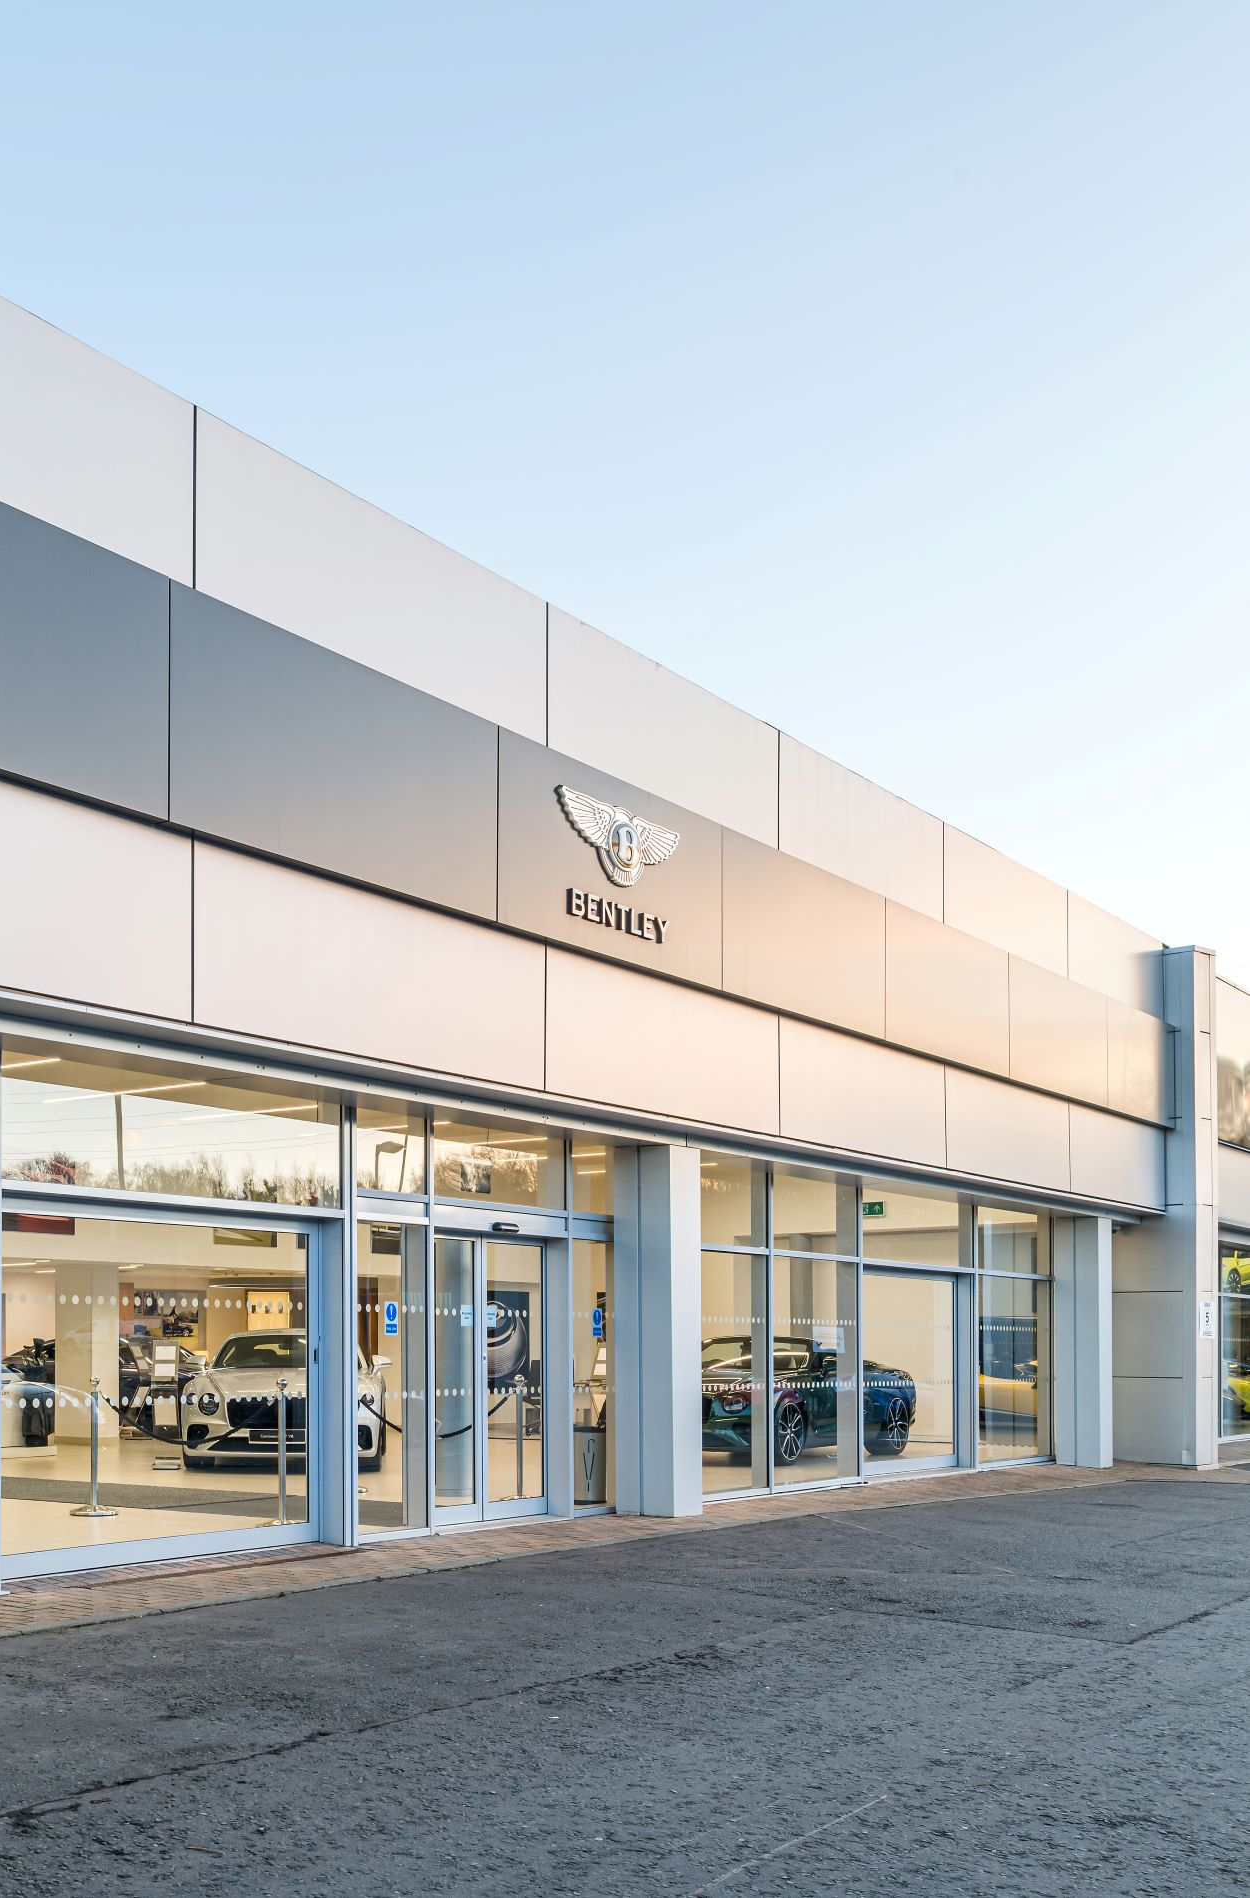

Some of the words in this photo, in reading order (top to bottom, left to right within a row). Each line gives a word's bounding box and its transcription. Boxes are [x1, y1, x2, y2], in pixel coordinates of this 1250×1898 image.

[617, 826, 640, 865] B
[567, 888, 670, 943] BENTLEY
[1205, 1312, 1210, 1323] 5
